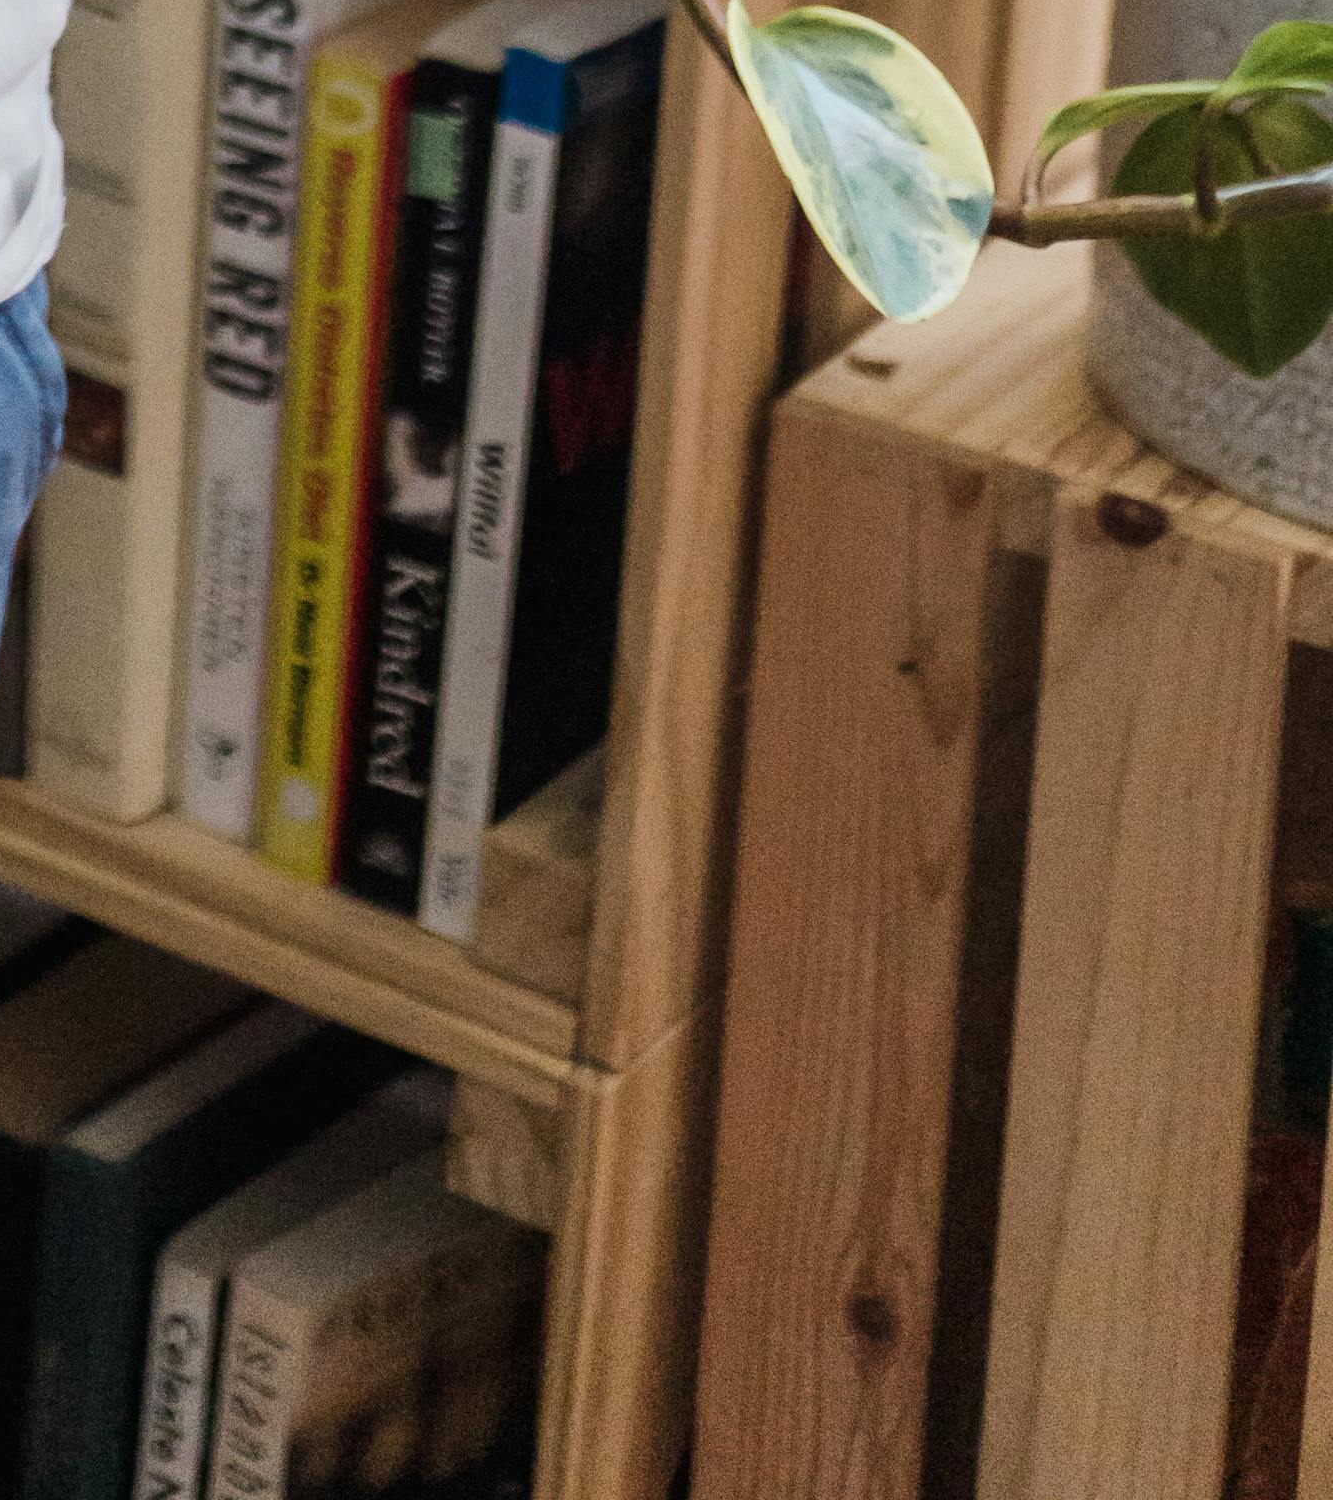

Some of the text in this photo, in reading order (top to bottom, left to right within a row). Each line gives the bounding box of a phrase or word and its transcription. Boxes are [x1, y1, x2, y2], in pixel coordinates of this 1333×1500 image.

[201, 259, 281, 403] RED
[368, 556, 441, 798] Kindred
[223, 1322, 291, 1500] Istanb
